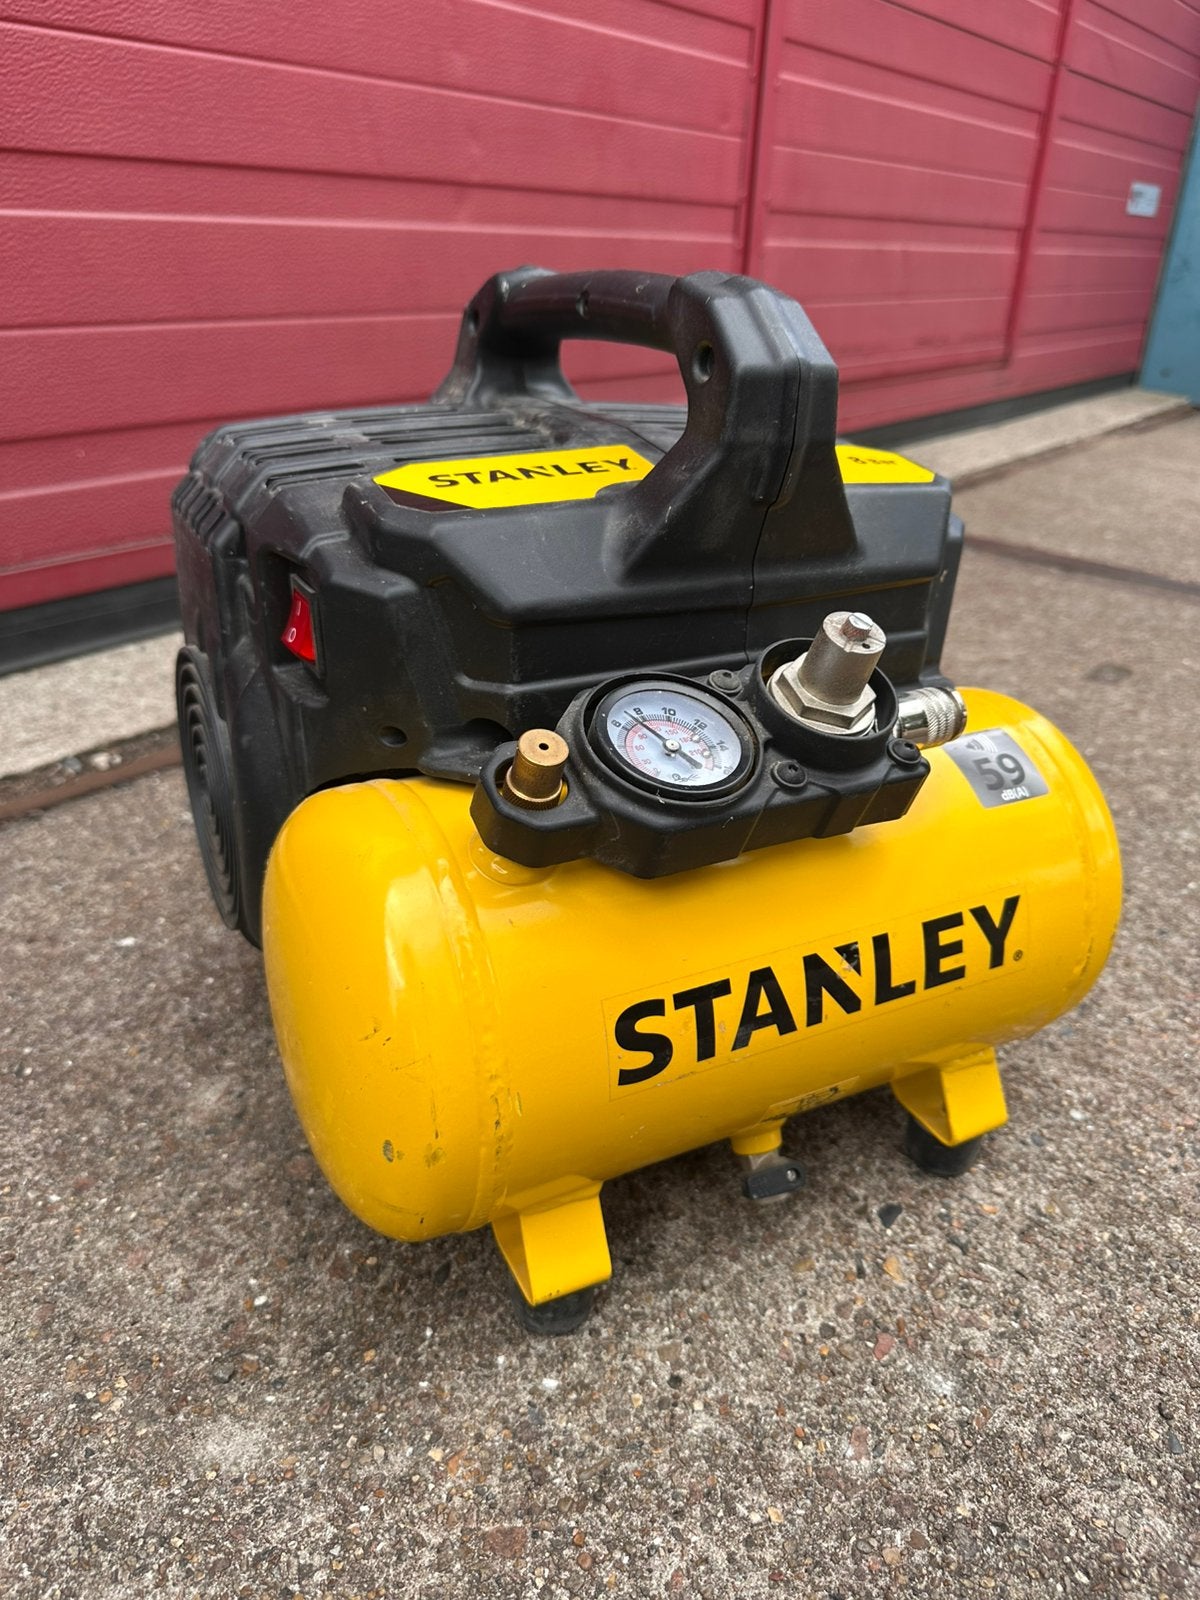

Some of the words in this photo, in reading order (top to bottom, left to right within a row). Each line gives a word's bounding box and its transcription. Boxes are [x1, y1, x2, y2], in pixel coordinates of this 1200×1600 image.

[427, 458, 631, 488] STANLEY
[633, 707, 643, 716] 8
[661, 707, 677, 716] 10
[611, 719, 622, 728] 6
[694, 718, 708, 730] 12
[716, 739, 729, 752] 14
[973, 753, 1026, 791] 59
[1001, 786, 1029, 801] dB(A)
[614, 895, 1021, 1086] STANLEY
